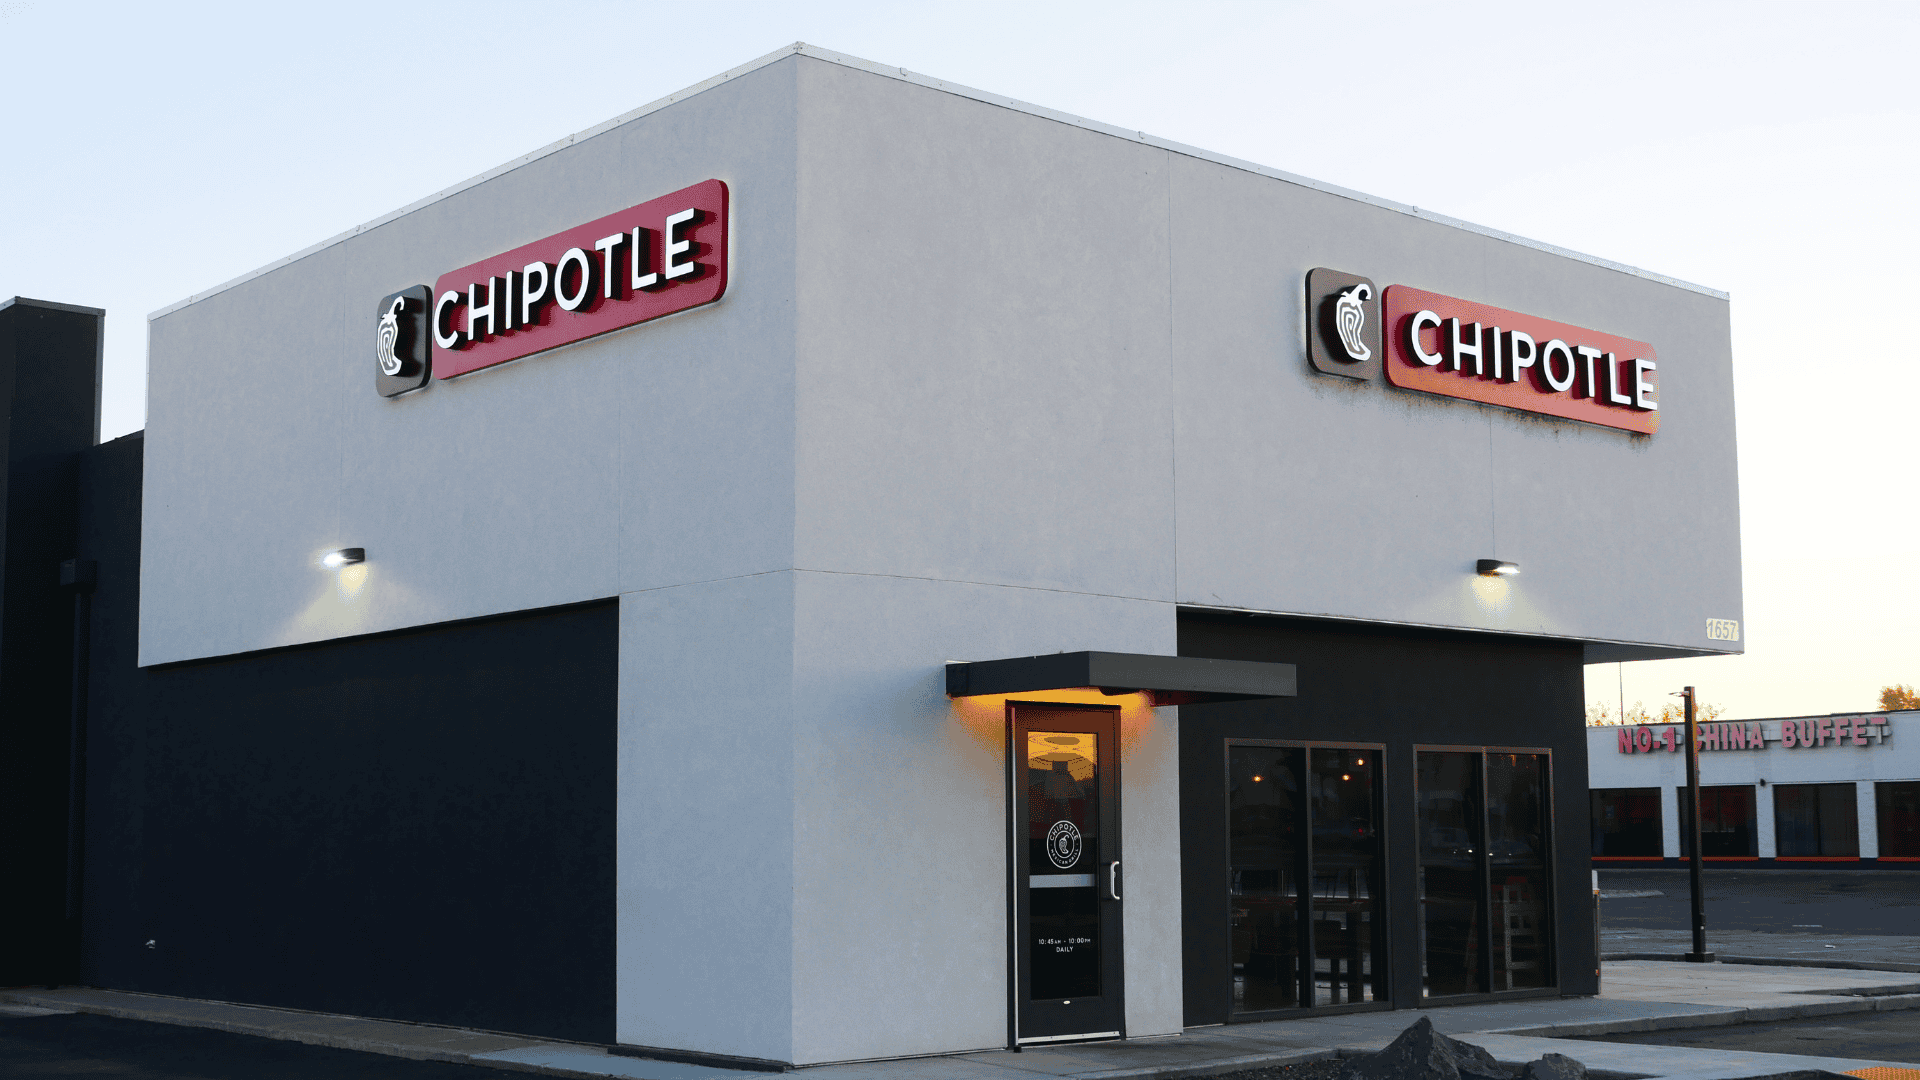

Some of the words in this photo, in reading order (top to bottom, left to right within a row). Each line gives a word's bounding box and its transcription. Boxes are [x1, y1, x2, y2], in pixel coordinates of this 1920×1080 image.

[433, 208, 695, 349] CHIPOTLE
[1411, 310, 1658, 410] CHIPOTLE
[1708, 620, 1736, 639] 1657
[1781, 717, 1887, 748] BUFFET
[1050, 823, 1079, 841] CHIPOTLE
